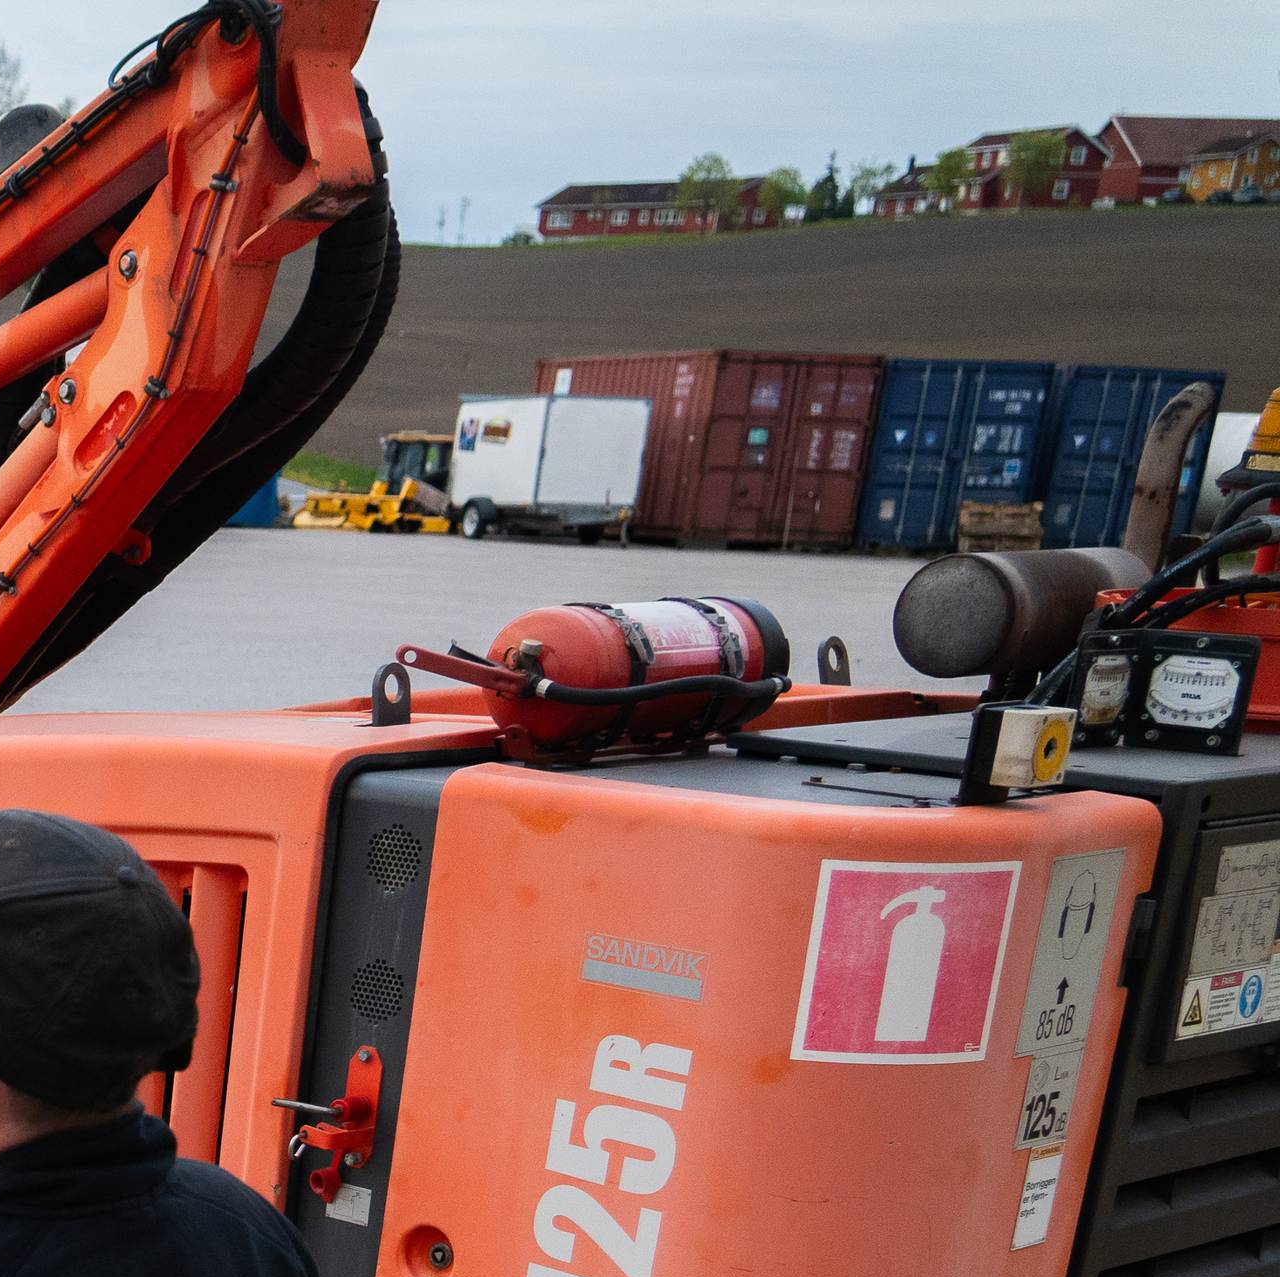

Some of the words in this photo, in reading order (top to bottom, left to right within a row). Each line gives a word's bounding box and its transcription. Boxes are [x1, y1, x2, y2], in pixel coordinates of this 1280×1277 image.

[587, 935, 705, 977] SANDVIK
[1035, 1009, 1055, 1041] 85
[1056, 1004, 1076, 1035] dB
[1022, 1091, 1061, 1142] 125
[1055, 1111, 1067, 1133] dB
